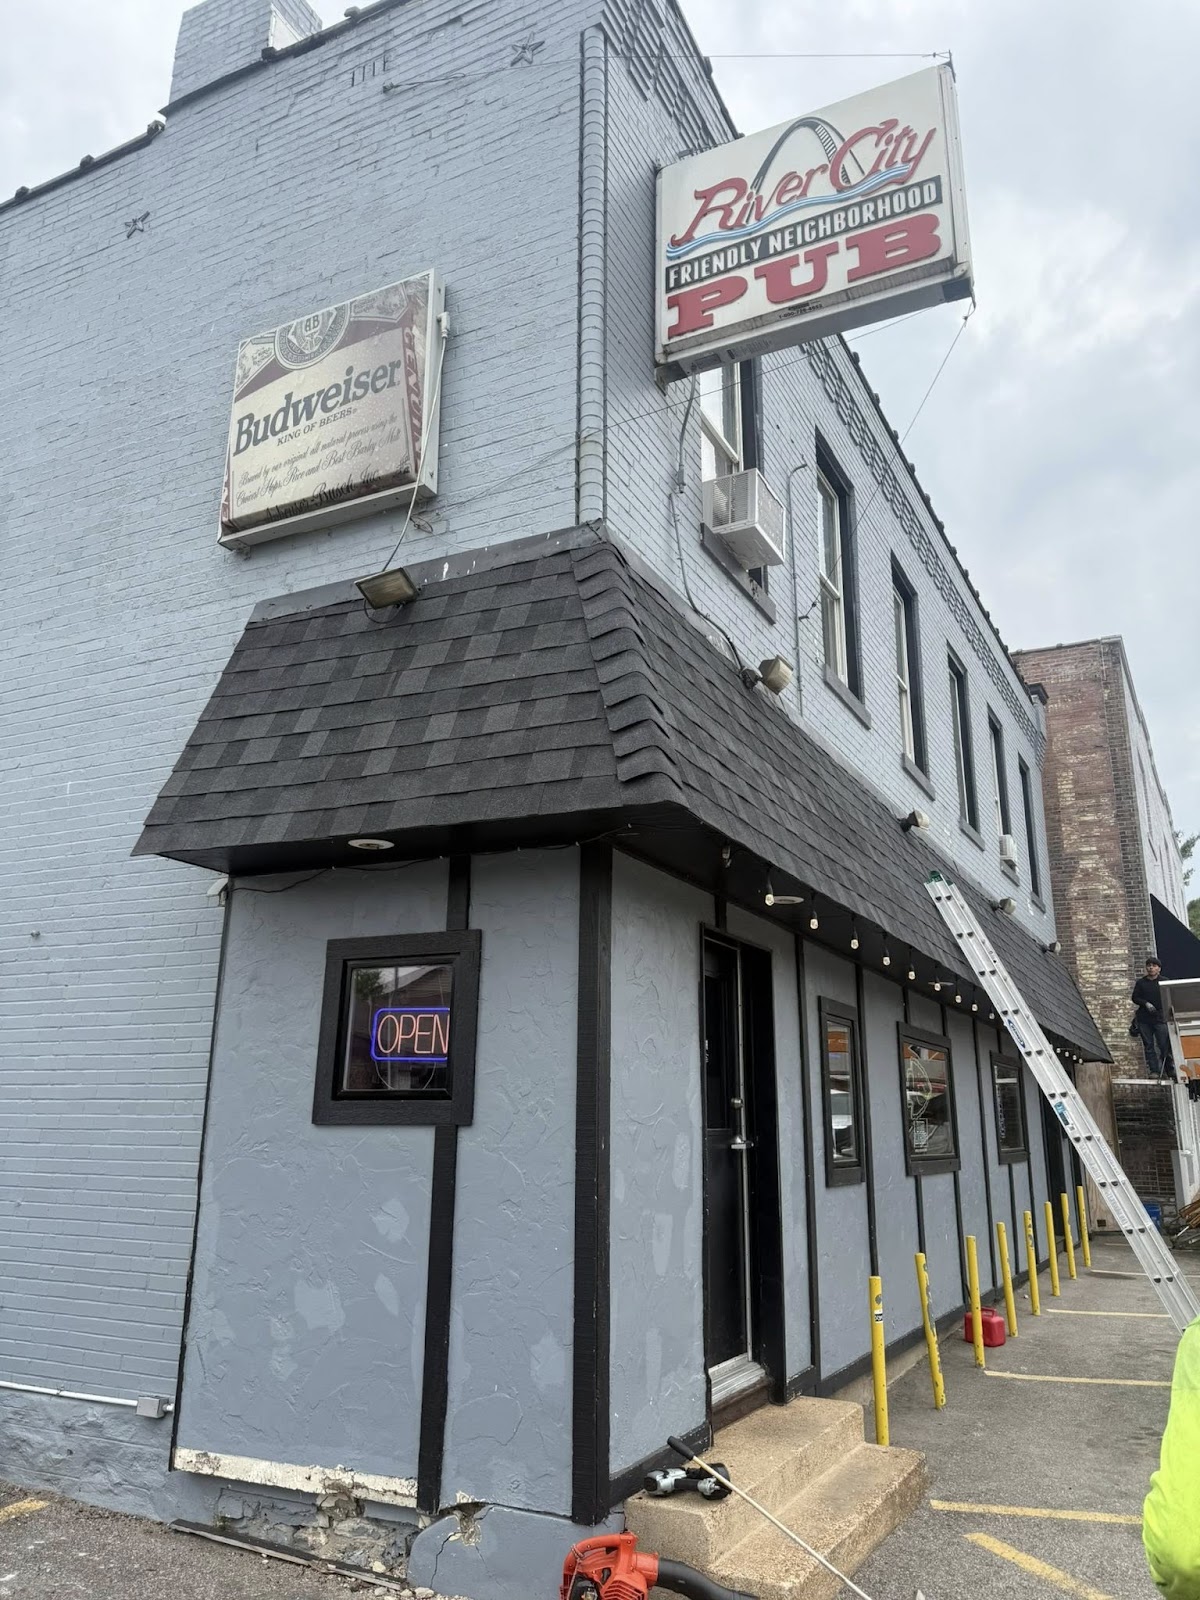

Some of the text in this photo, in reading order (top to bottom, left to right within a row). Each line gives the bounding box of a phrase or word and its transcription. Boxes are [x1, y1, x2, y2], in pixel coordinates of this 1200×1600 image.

[670, 118, 937, 247] River City
[668, 181, 938, 288] FRIENDLY NEIGHBORHOOD
[667, 213, 942, 340] PUB
[233, 359, 402, 457] Budweiser
[277, 429, 301, 446] KING
[303, 420, 318, 434] OF
[283, 446, 309, 469] original
[309, 440, 321, 455] all
[304, 459, 322, 477] and
[321, 449, 347, 471] Best
[347, 438, 378, 461] Barley
[377, 1014, 450, 1054] OPEN
